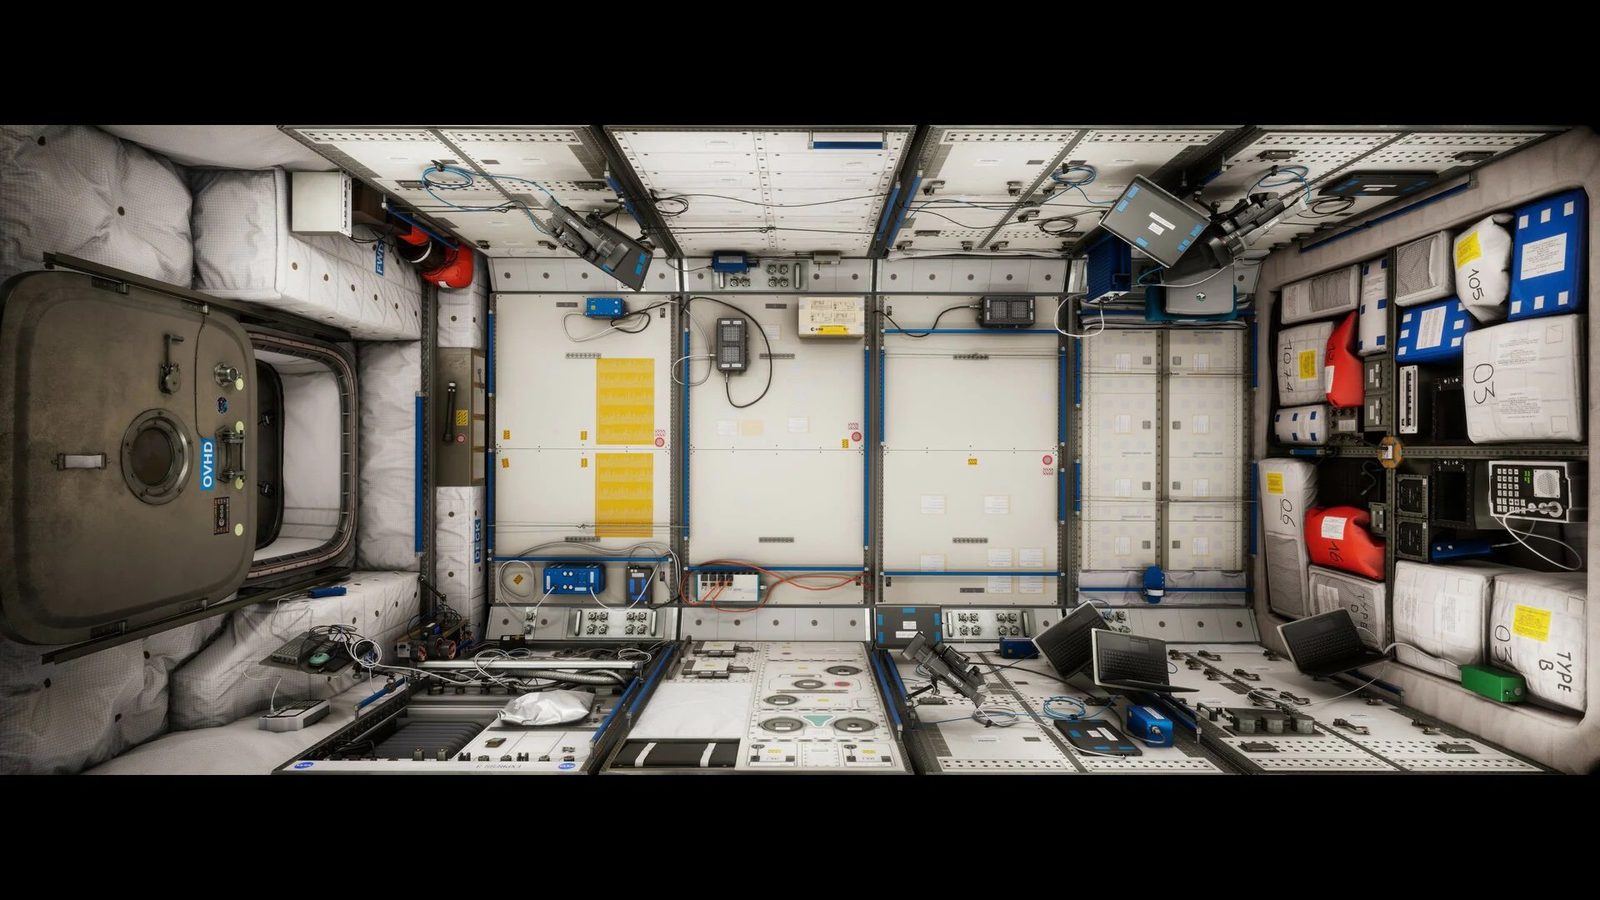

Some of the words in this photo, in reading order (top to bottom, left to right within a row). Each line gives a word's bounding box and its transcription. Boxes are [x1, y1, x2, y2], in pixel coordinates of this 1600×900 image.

[1468, 269, 1484, 300] 105
[1473, 363, 1496, 405] 03
[203, 441, 213, 488] OVHD
[1281, 498, 1296, 528] 06
[1495, 625, 1513, 663] 03
[1538, 658, 1554, 671] B
[1556, 652, 1573, 693] TYPE
